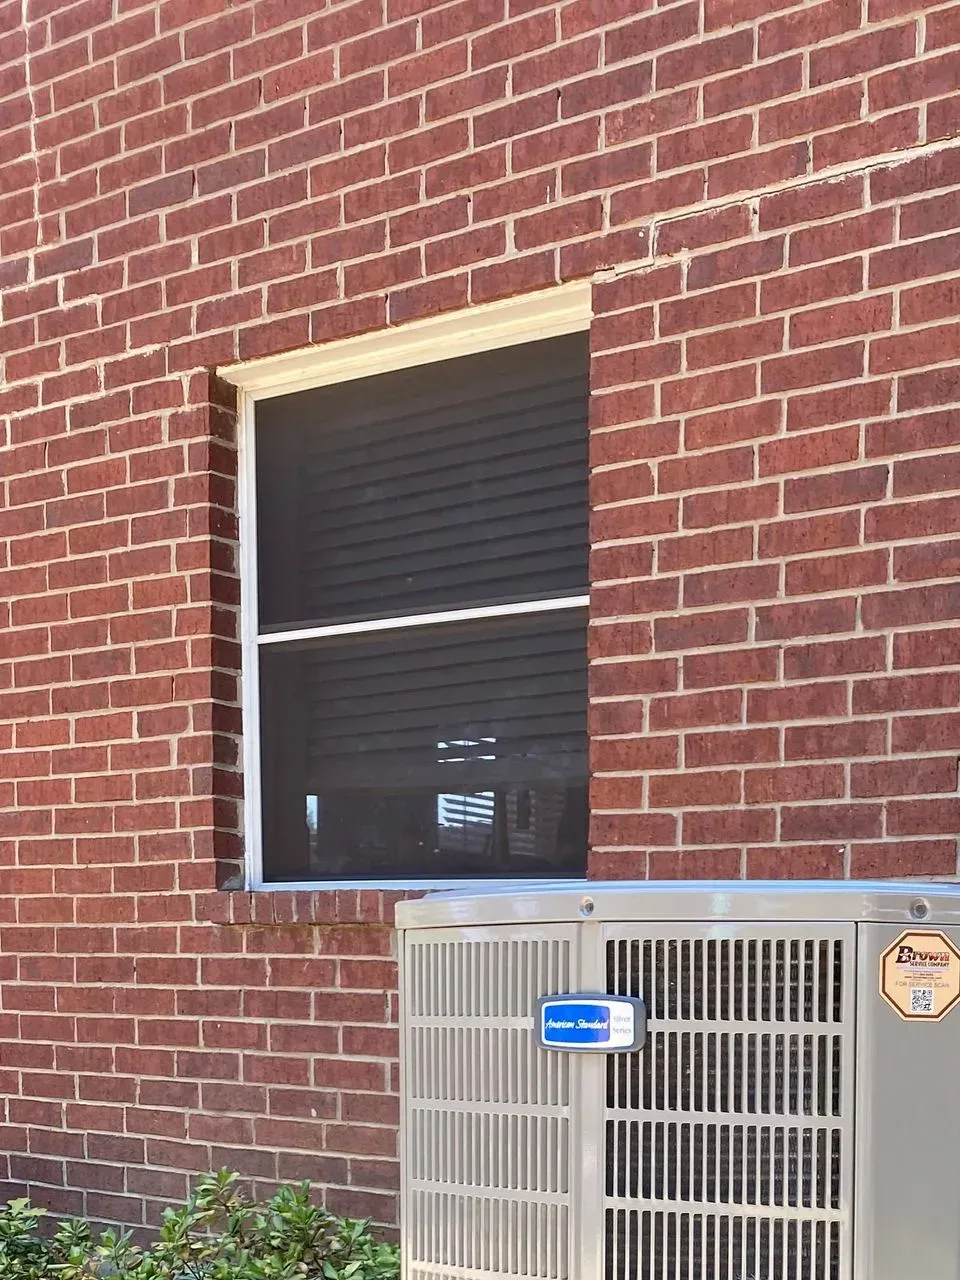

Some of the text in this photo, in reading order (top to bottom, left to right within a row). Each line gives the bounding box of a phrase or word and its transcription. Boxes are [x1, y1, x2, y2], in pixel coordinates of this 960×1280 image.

[895, 946, 950, 963] Brown
[545, 1018, 610, 1029] American Standard
